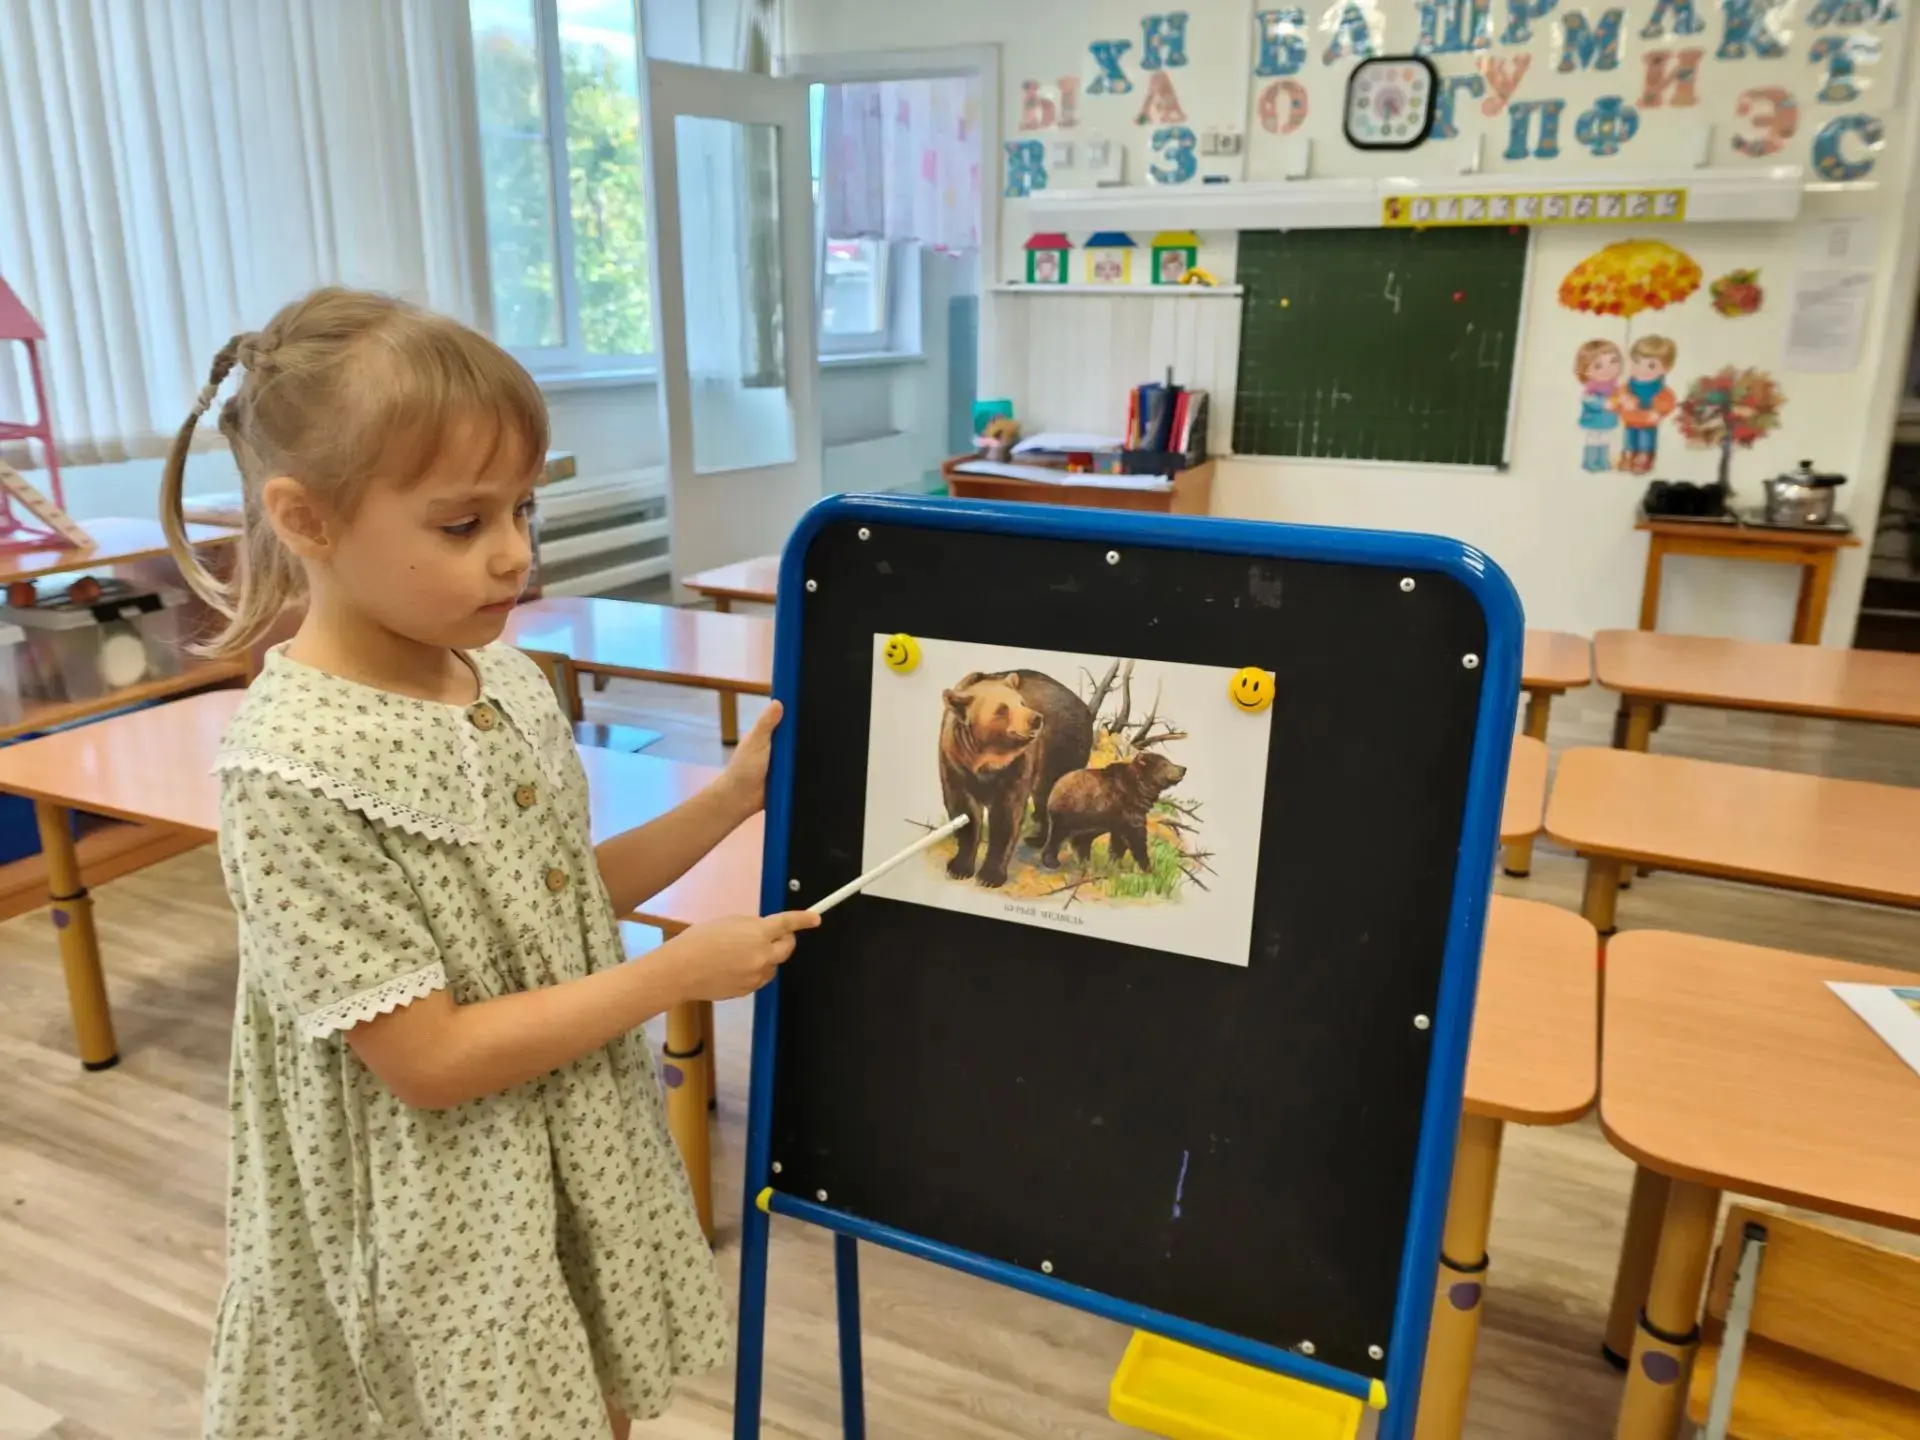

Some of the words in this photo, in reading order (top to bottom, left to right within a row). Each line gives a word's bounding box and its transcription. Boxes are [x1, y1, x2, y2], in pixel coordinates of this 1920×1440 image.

[1139, 10, 1189, 70] Н
[1557, 8, 1624, 74] М
[1715, 0, 1788, 60] К
[1086, 38, 1132, 95] Х
[1133, 69, 1188, 125] А
[1475, 53, 1532, 117] У
[1636, 46, 1704, 109] И
[1503, 98, 1565, 159] П
[1575, 95, 1639, 156] Ф
[1732, 85, 1797, 158] Э
[1811, 114, 1883, 182] С
[1383, 270, 1401, 315] 4
